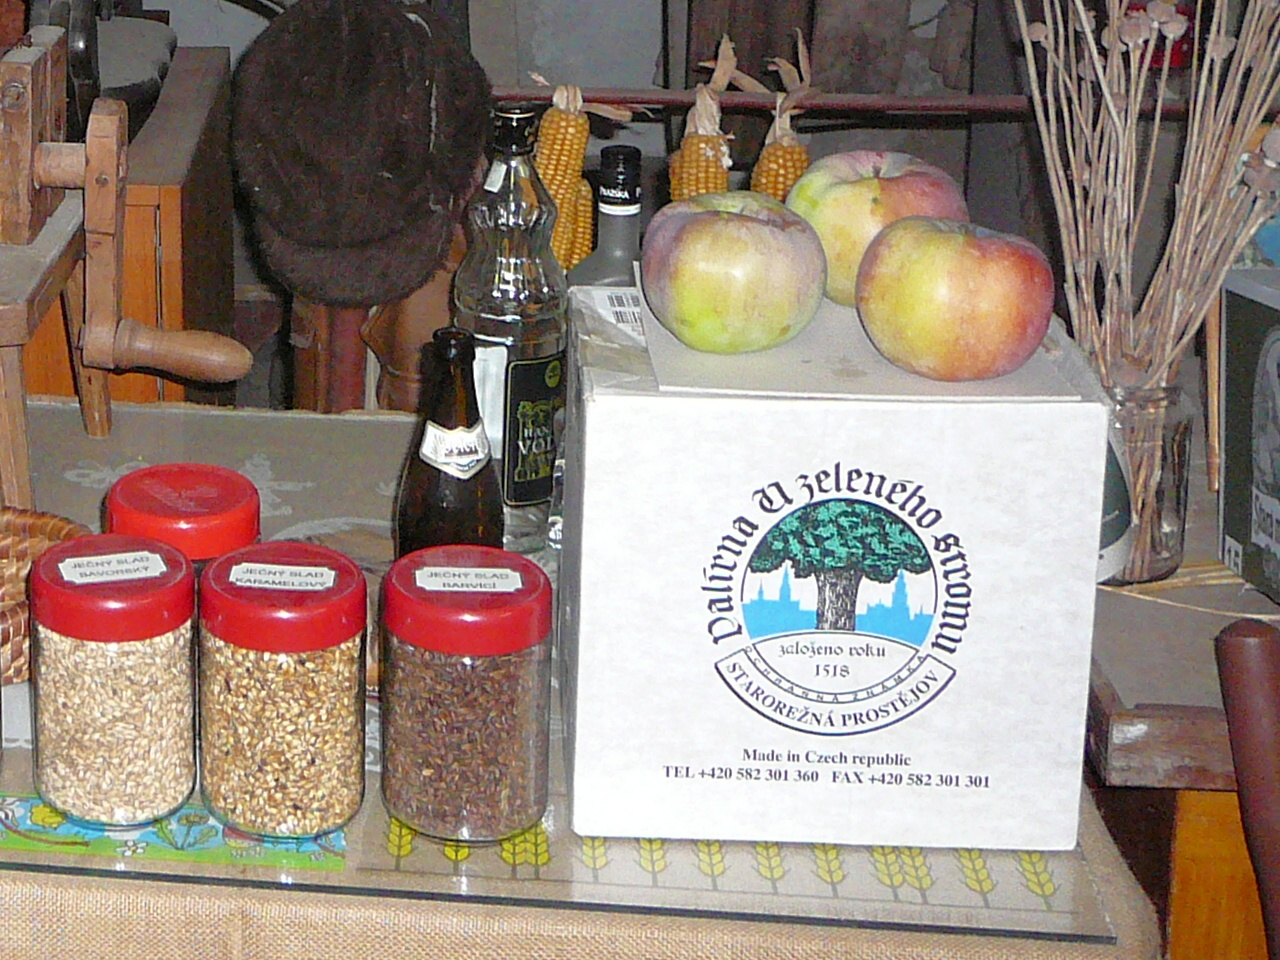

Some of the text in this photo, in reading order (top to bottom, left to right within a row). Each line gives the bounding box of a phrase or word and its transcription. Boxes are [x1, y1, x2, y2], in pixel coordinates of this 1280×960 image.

[794, 461, 943, 530] zeleného
[931, 531, 973, 654] stromu
[778, 643, 886, 658] založeno roku
[814, 663, 850, 678] 1518
[726, 661, 940, 728] STAROREŽNÁ PROSTĚJOV
[742, 748, 912, 768] Made in Czech republic
[662, 765, 991, 789] TEL +420 582 301 360 FAX +420 582 301 301
